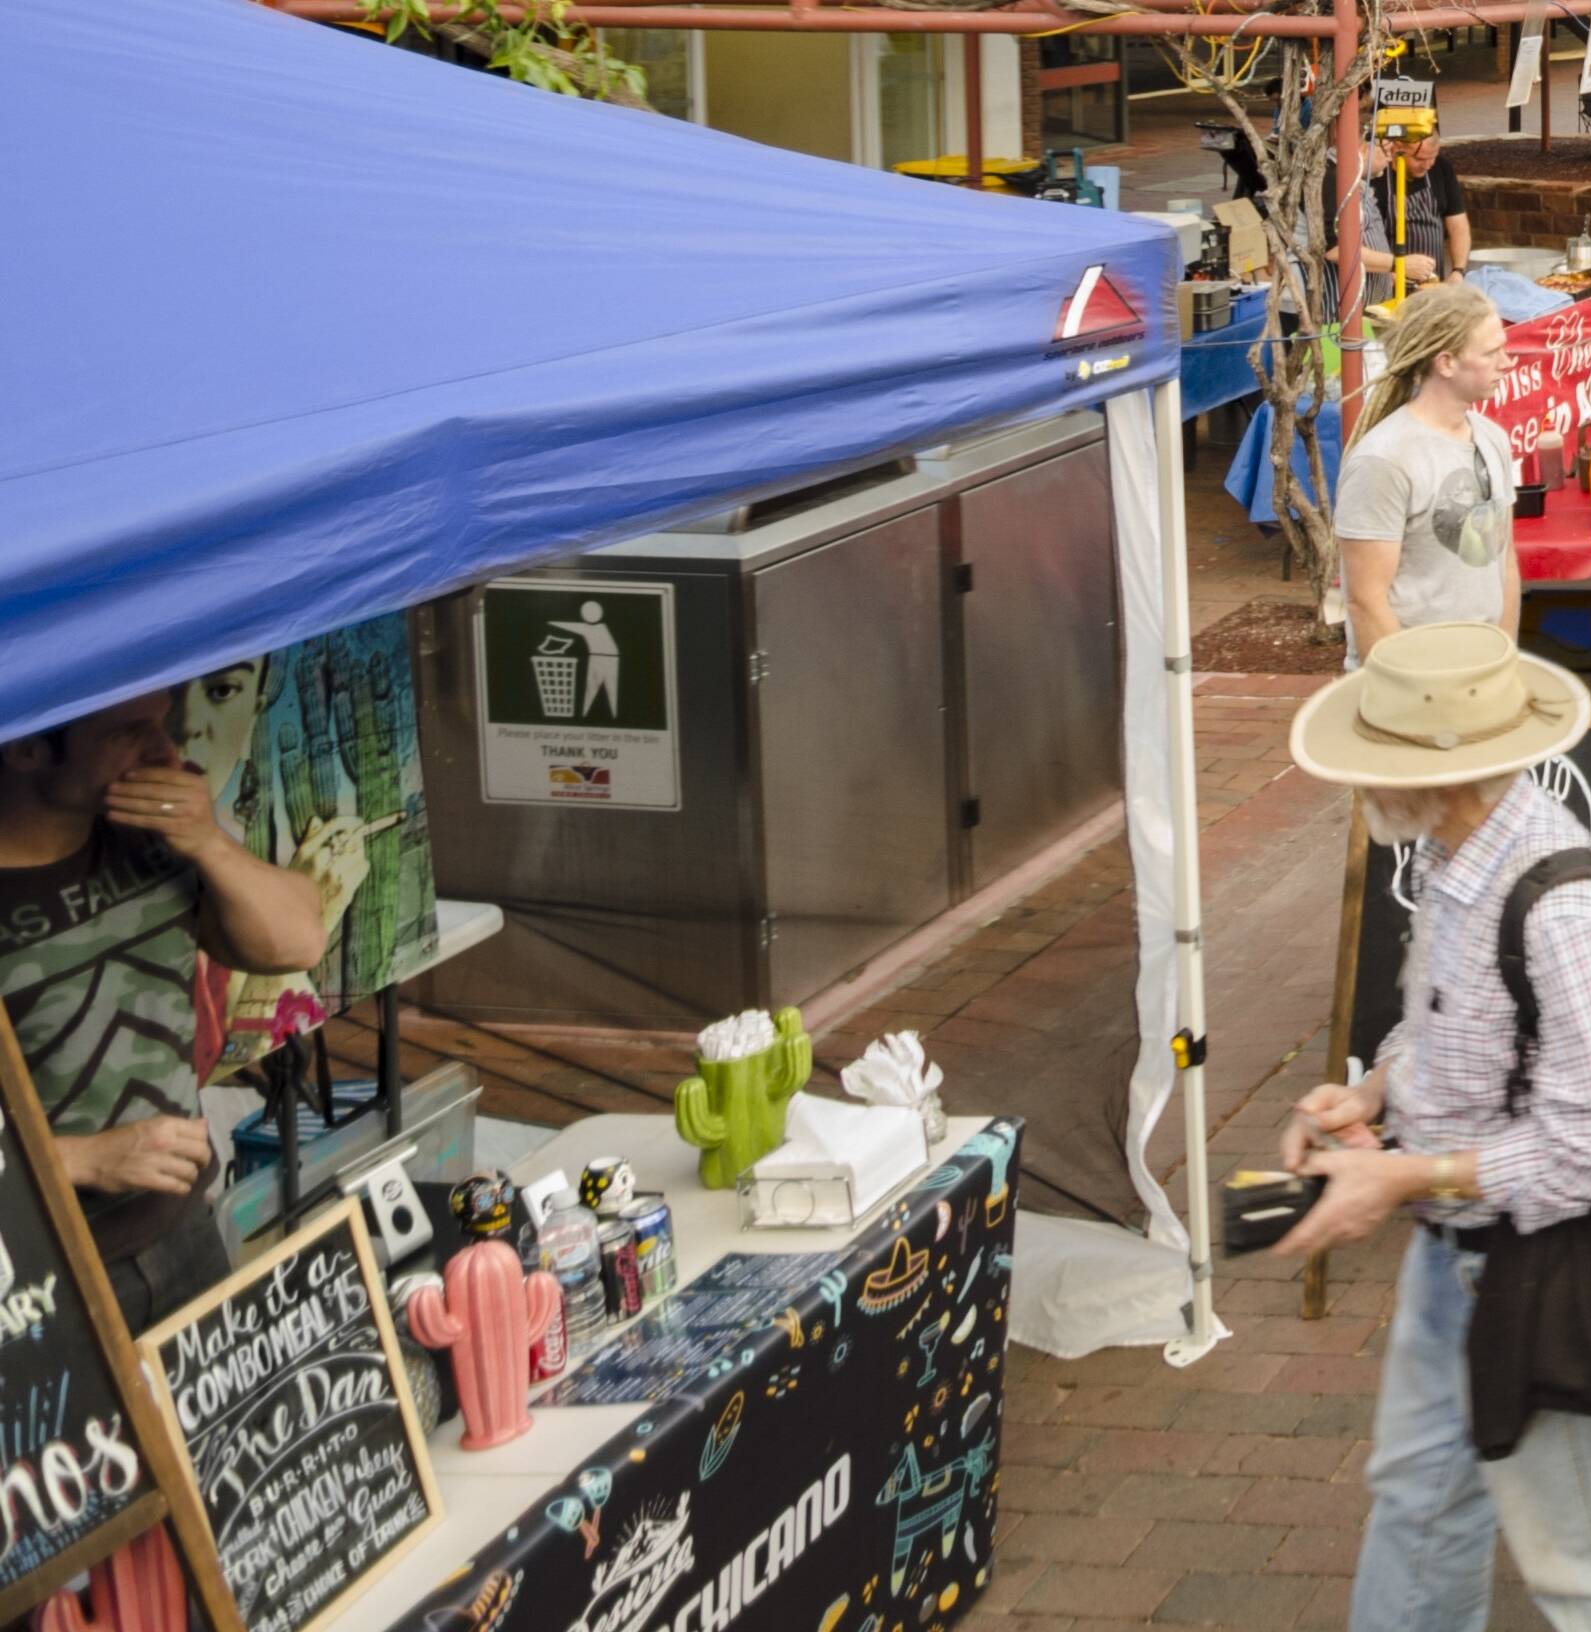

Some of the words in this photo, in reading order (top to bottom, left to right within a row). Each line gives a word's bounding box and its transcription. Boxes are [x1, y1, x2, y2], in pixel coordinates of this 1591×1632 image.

[541, 745, 585, 759] THANK
[590, 747, 619, 760] YOU
[166, 1300, 264, 1389] Make
